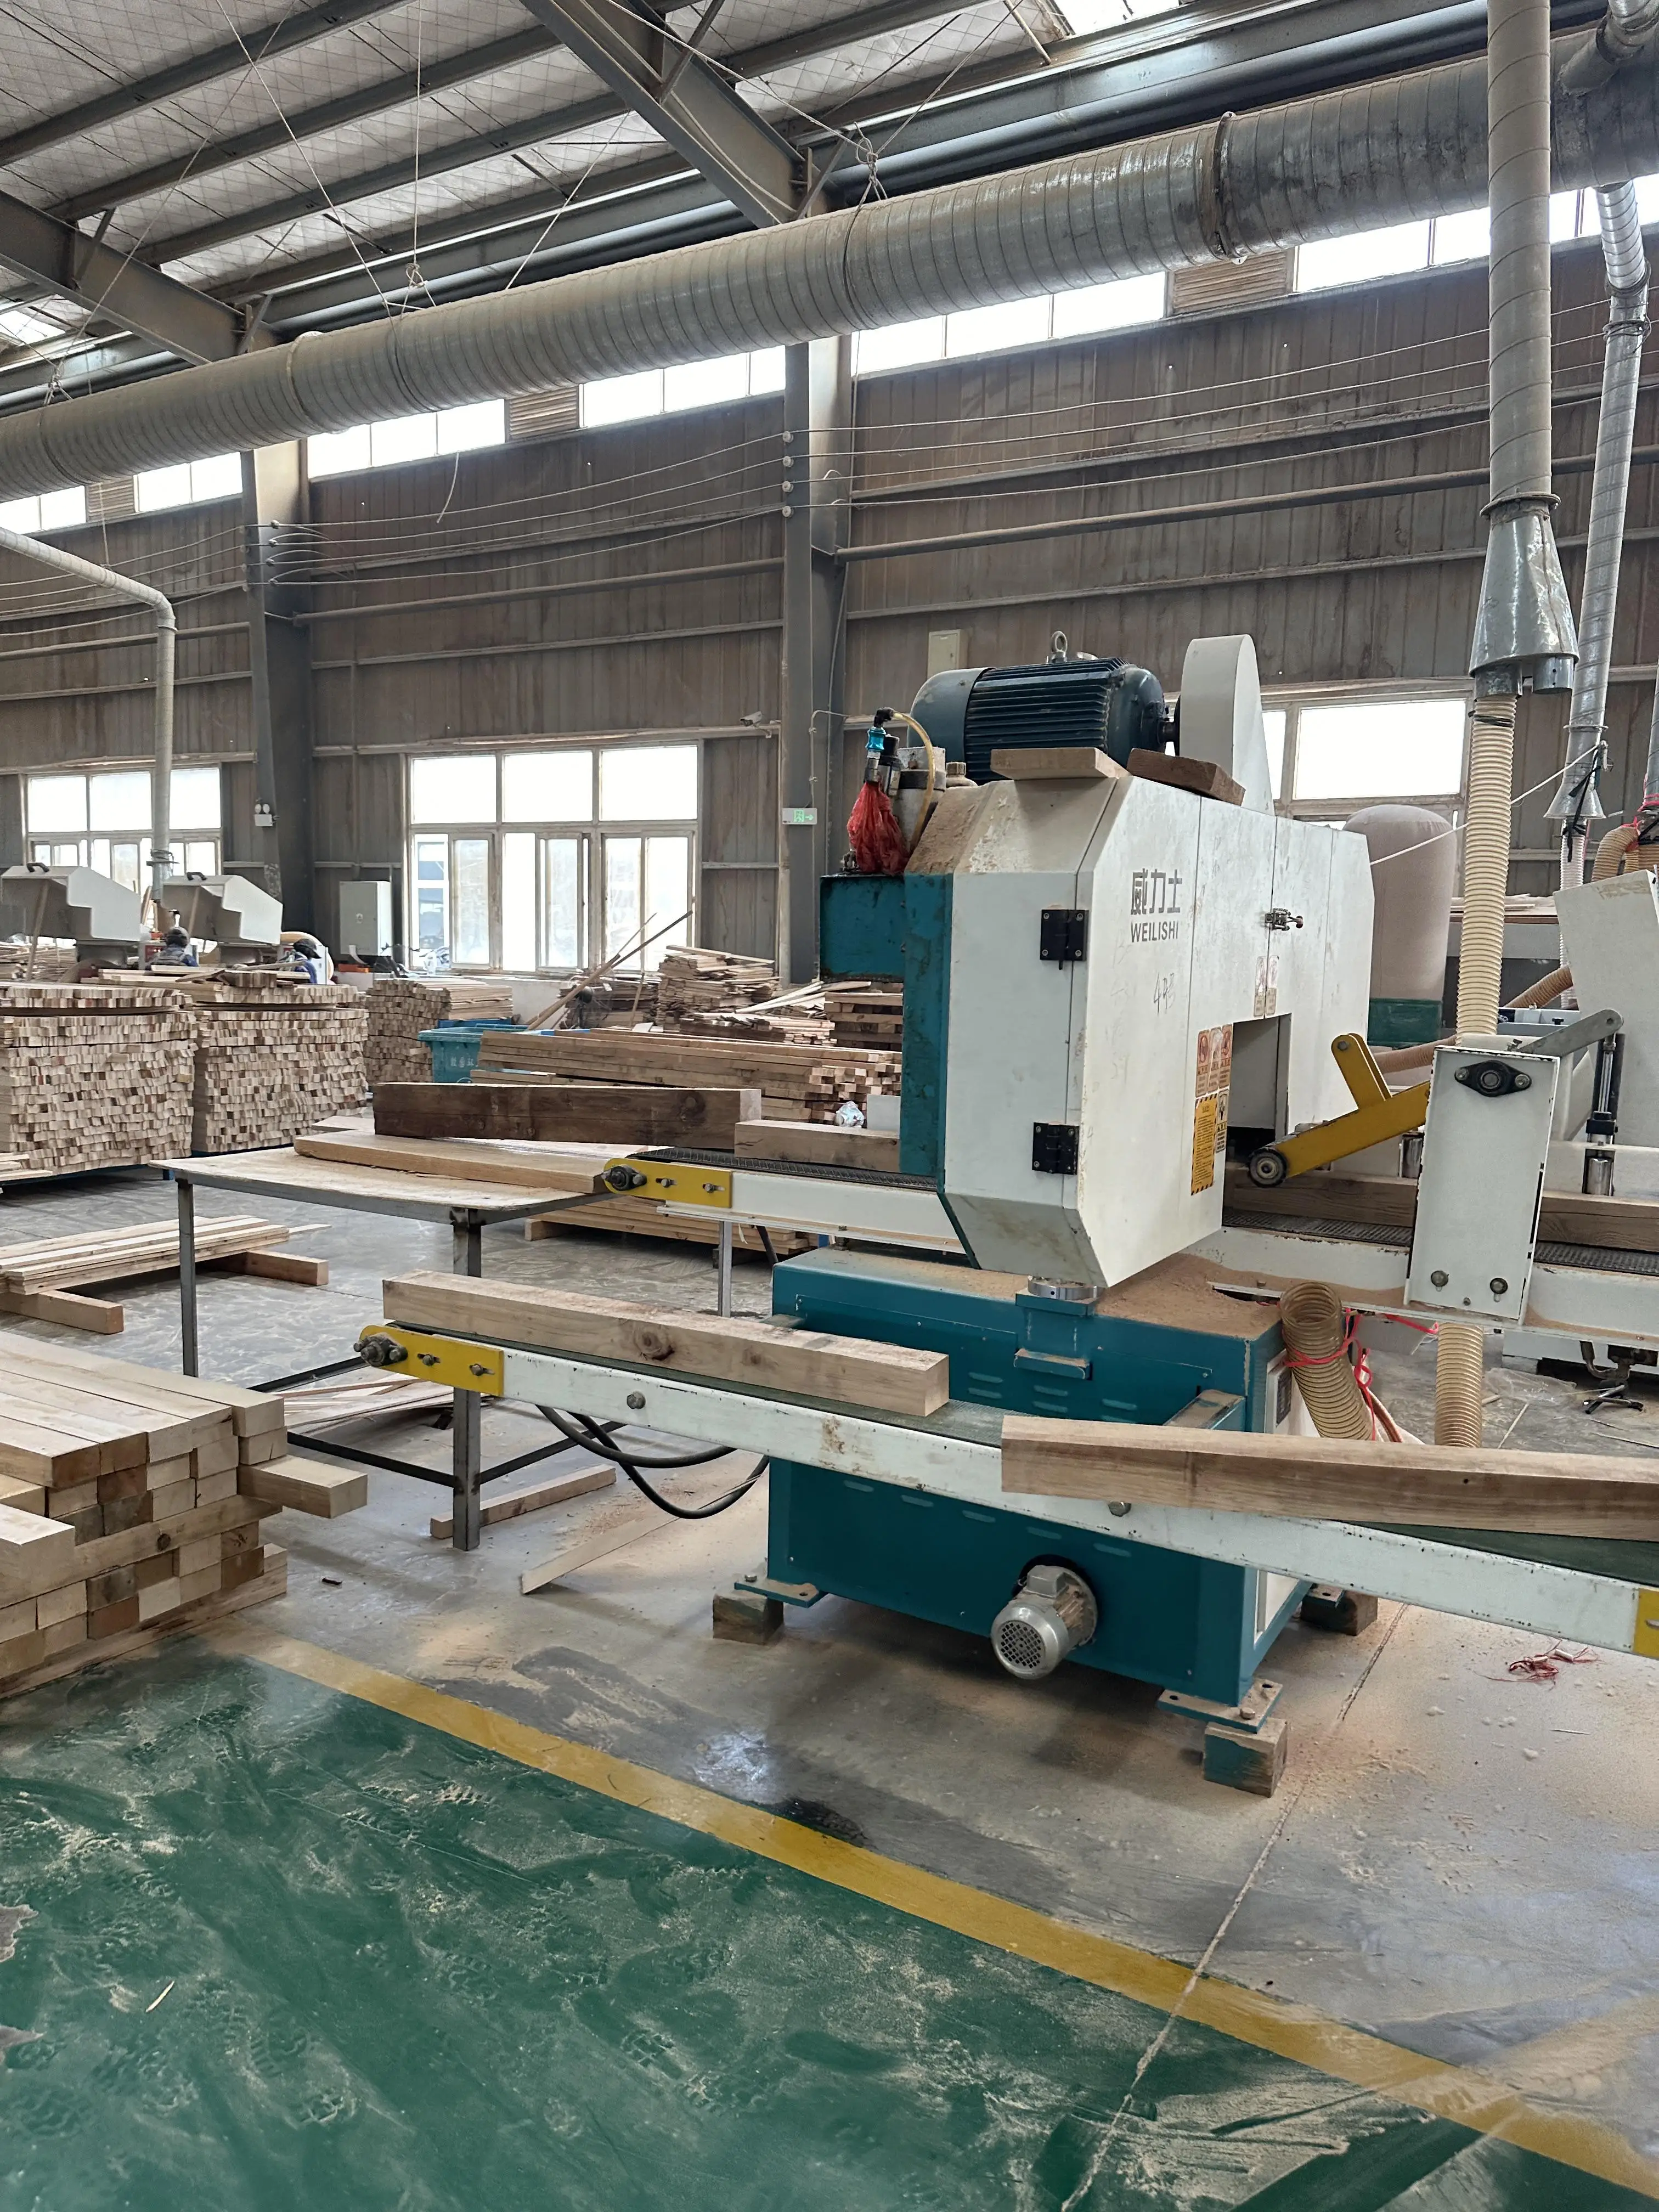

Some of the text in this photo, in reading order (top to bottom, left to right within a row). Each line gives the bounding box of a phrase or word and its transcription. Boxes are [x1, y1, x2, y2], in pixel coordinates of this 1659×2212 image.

[1131, 868, 1182, 915] 威力士
[1131, 921, 1178, 943] WEILISHI
